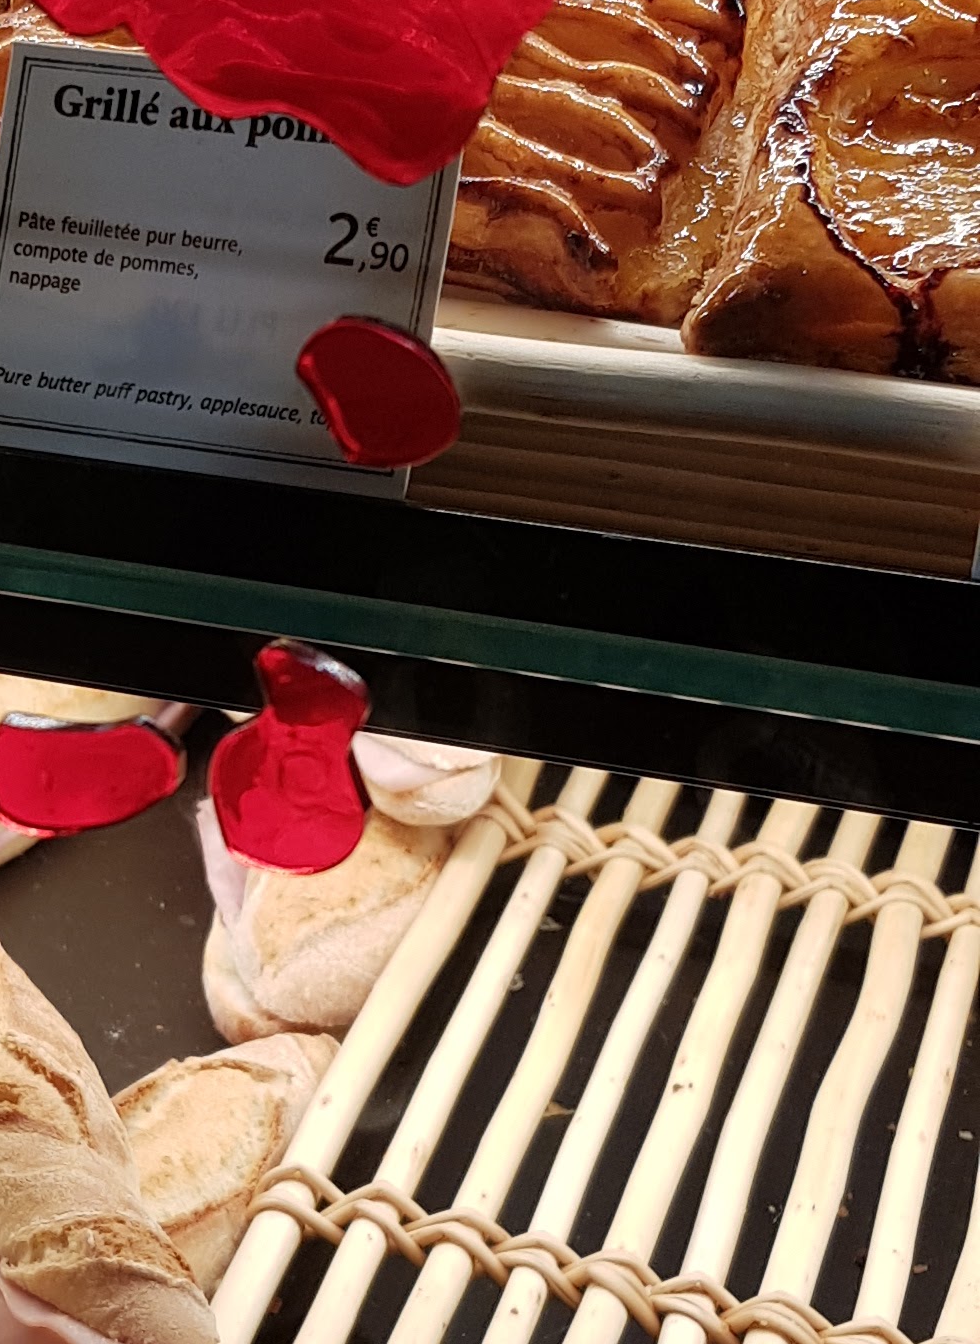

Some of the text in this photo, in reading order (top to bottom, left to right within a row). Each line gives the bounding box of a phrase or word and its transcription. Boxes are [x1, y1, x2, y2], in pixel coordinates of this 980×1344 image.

[54, 84, 161, 126] Grillé
[169, 104, 236, 135] aux
[17, 211, 244, 257] Pâte feuilletée pur beurre,
[9, 269, 81, 294] nappage
[13, 241, 199, 280] compote de pommes,
[37, 372, 92, 394] butter
[94, 382, 136, 400] puff
[134, 387, 192, 411] pastry,
[200, 396, 301, 424] applesauce,
